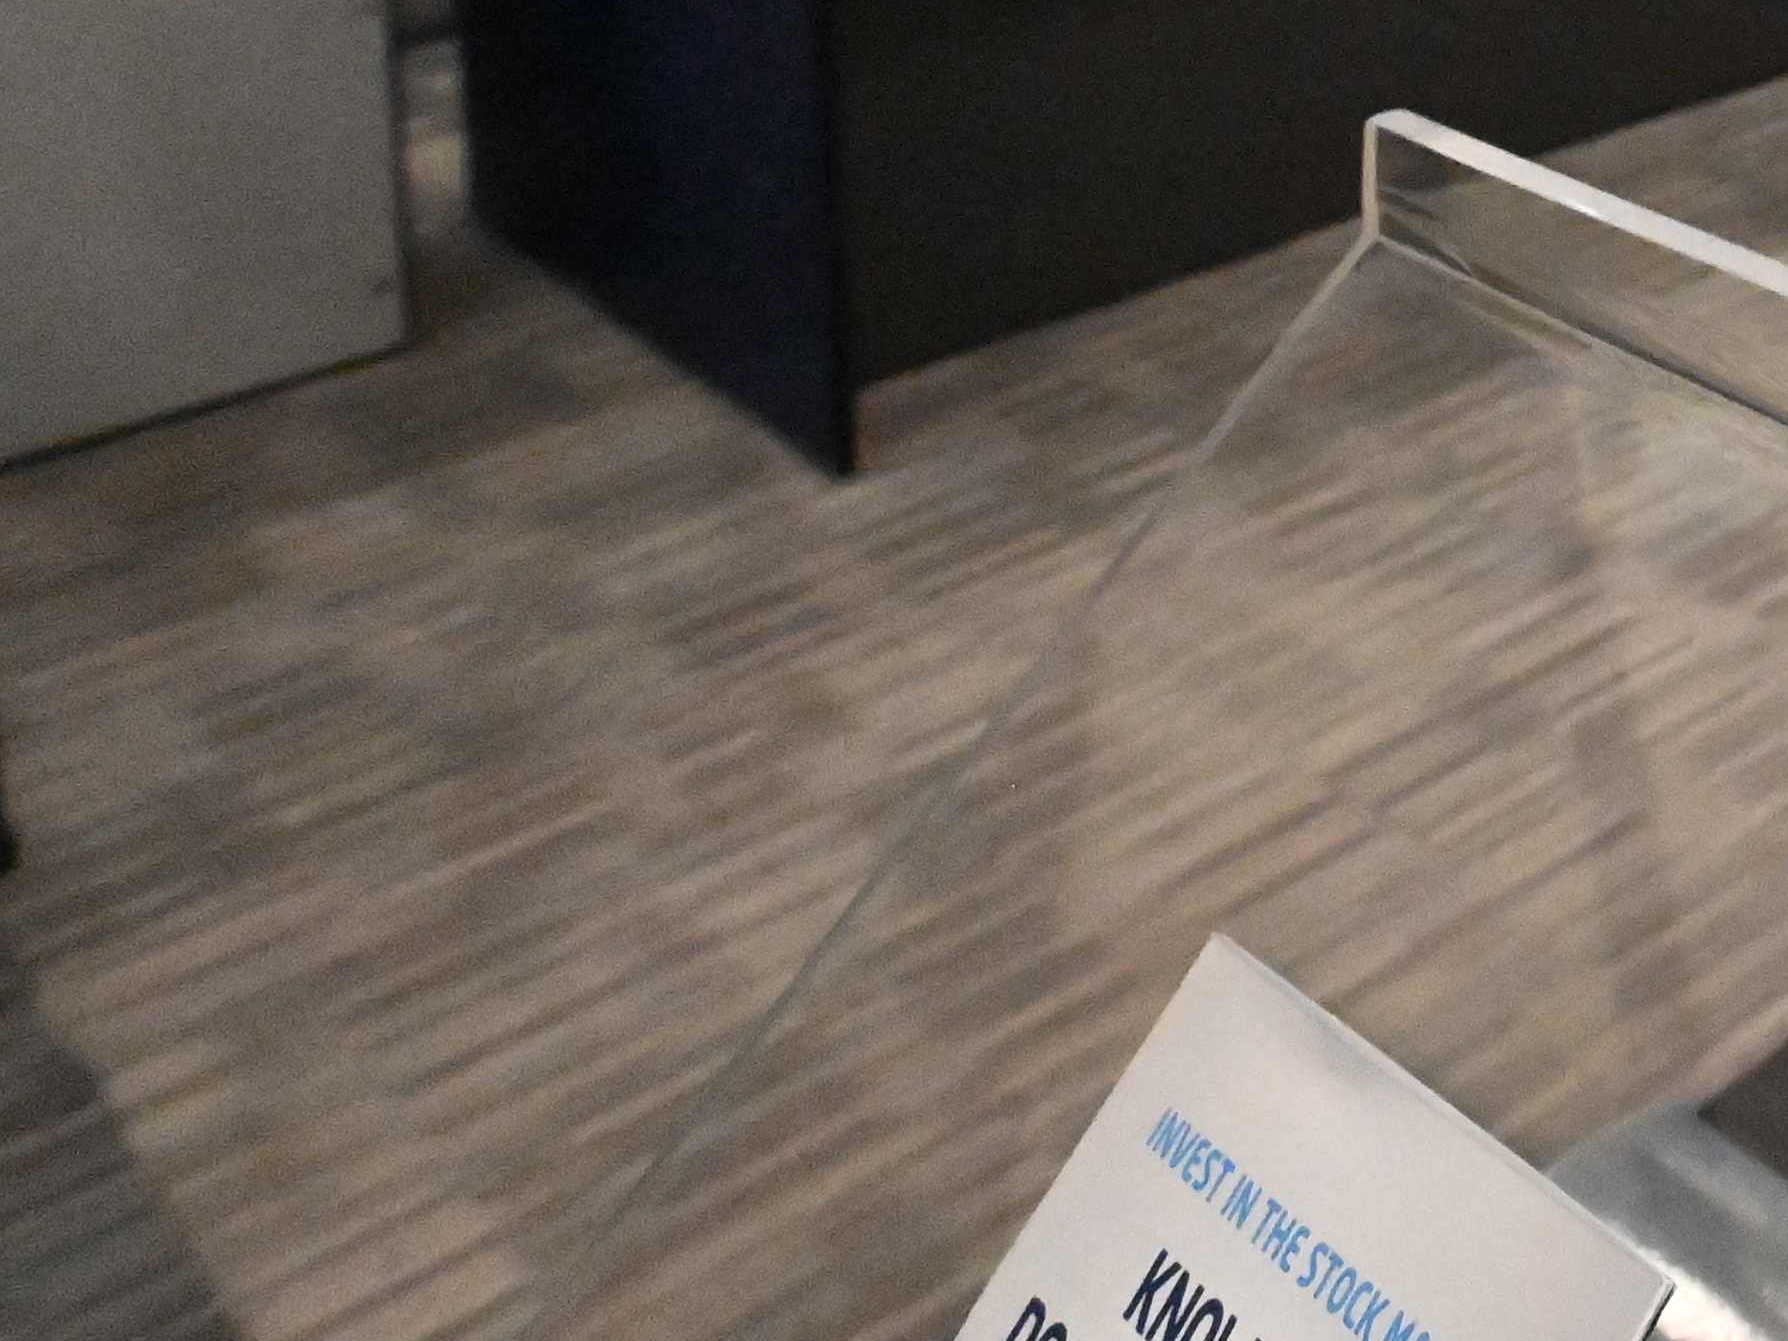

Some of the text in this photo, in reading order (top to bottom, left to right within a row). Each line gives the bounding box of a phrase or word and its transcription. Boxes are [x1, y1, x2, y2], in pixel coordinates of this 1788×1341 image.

[1145, 1105, 1237, 1204] INVEST
[1219, 1173, 1263, 1231] IN
[1250, 1197, 1311, 1274] THE
[1295, 1240, 1391, 1341] STOCK
